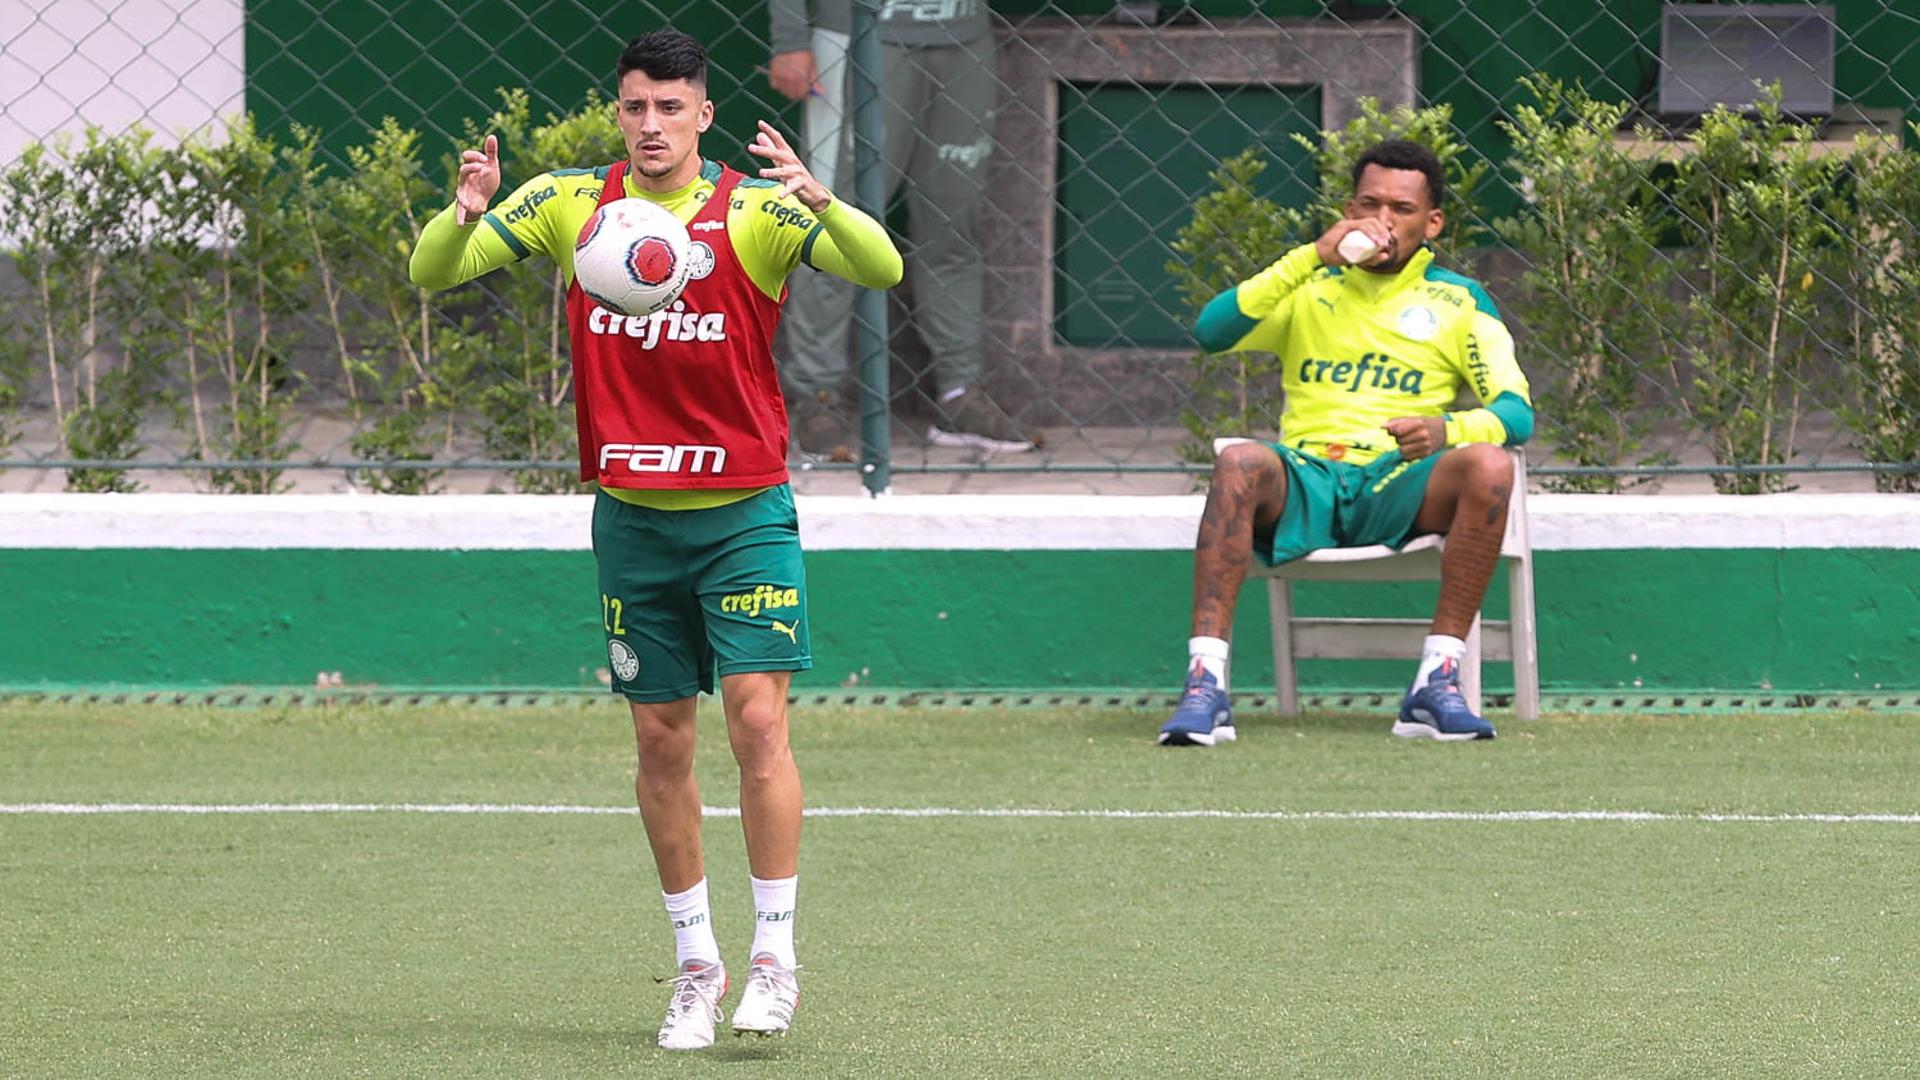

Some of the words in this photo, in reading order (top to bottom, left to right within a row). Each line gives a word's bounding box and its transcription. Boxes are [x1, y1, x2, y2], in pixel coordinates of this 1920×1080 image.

[505, 185, 557, 224] crefisa
[761, 199, 813, 230] crefisa
[589, 300, 726, 350] crefisa
[1300, 352, 1424, 395] crefisa
[1466, 333, 1490, 398] crefisa
[720, 584, 799, 617] crefisa
